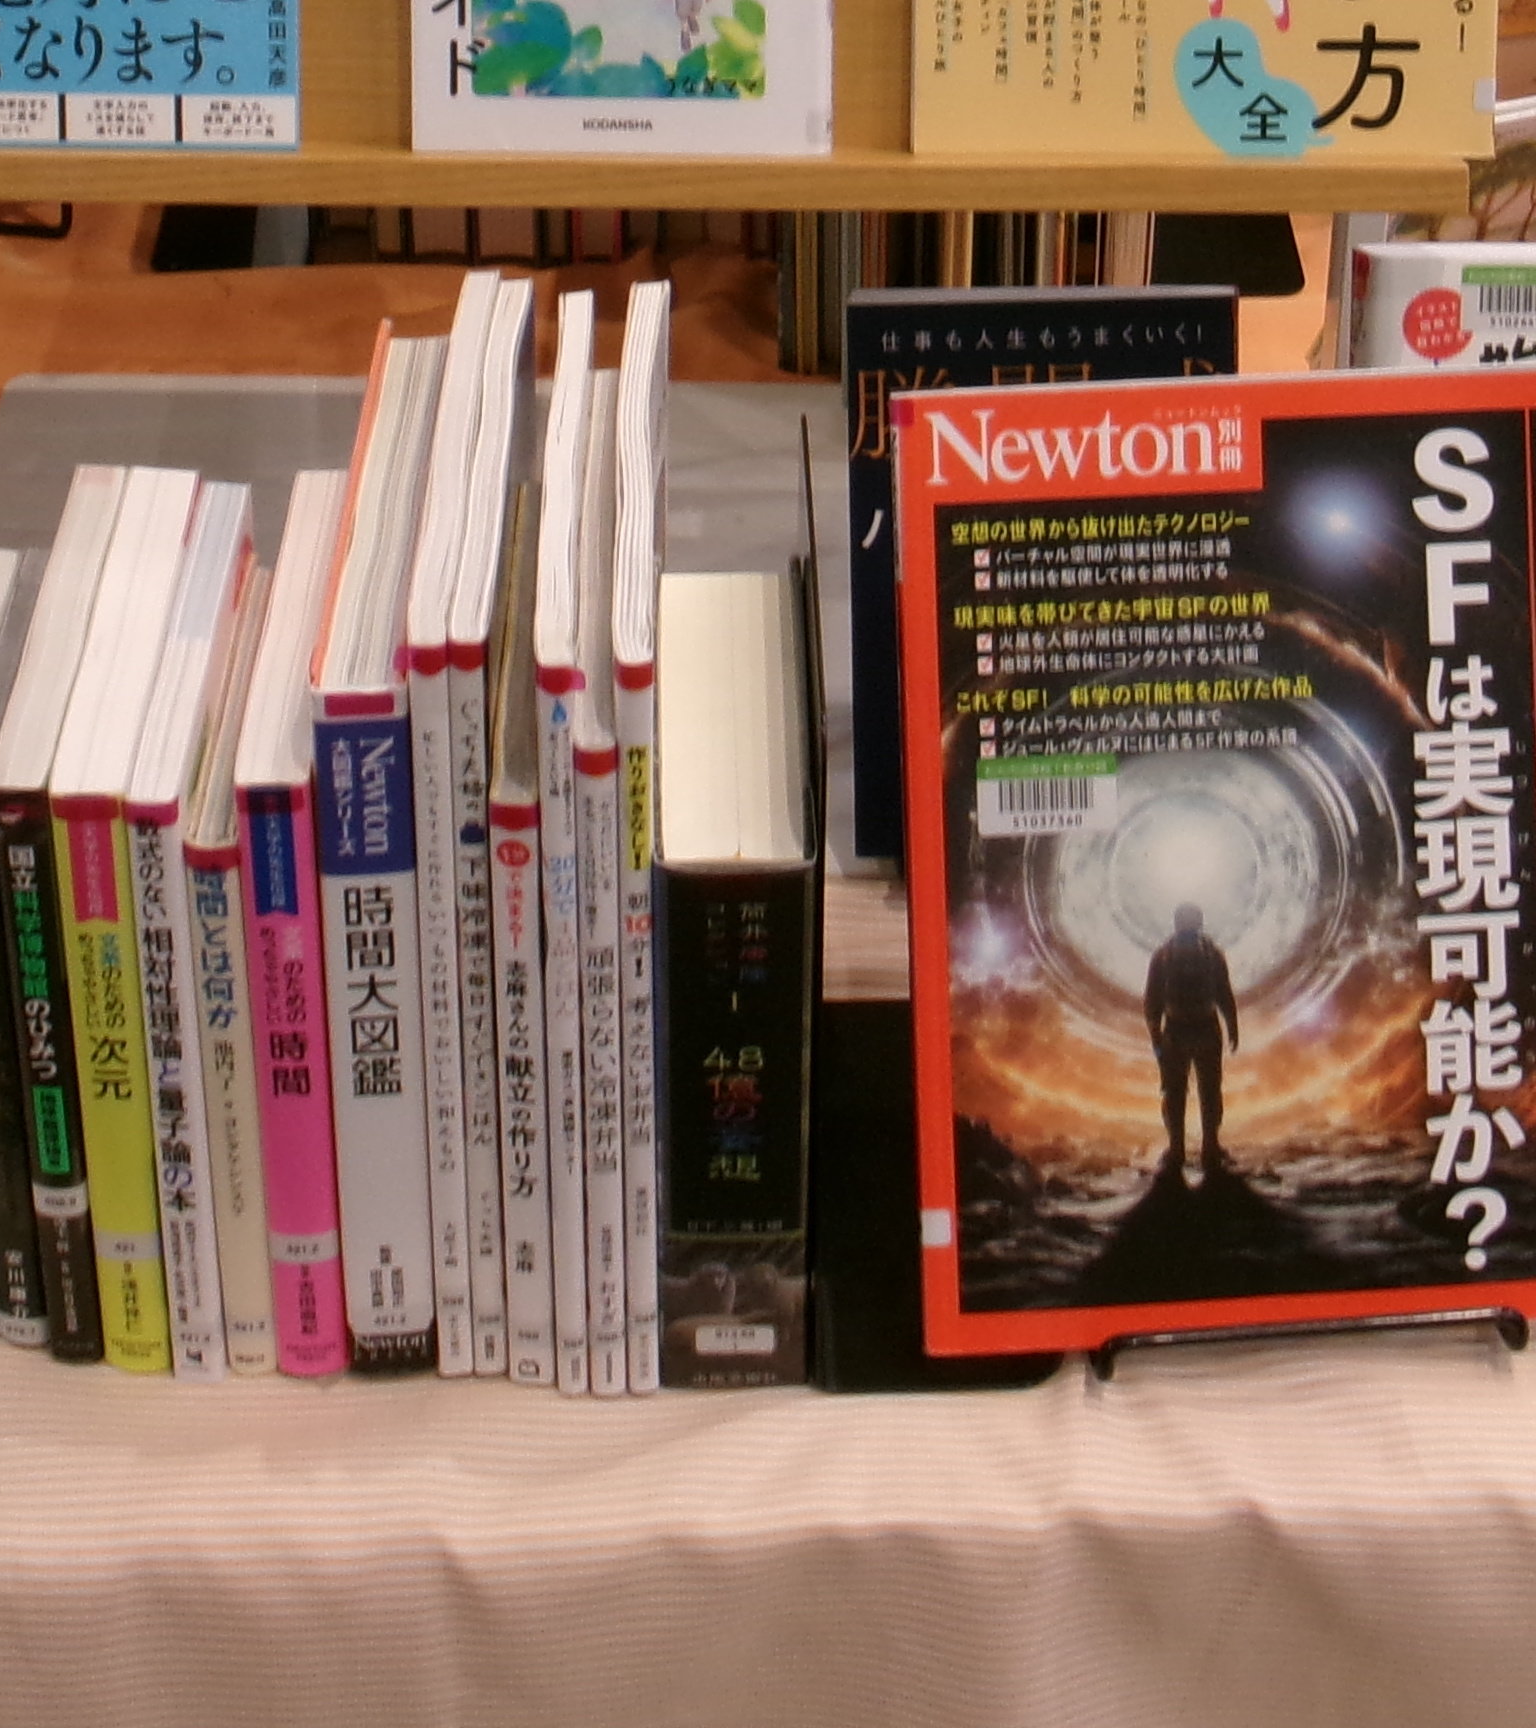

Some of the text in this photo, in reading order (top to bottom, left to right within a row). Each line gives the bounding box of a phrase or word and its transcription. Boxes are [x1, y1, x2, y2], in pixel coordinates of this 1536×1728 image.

[1192, 36, 1290, 142] 大全
[582, 117, 654, 132] KODANSHA
[880, 323, 1205, 353] 仕事も人生もうまくいく！
[925, 407, 1244, 486] Newton 別冊
[951, 510, 1250, 546] 空想の世界から抜け出たテクノロジー
[996, 562, 1229, 589] 新材料を駆使して体を透明化する
[953, 592, 1272, 630] 現実味を帯びてきた宇宙SFの世界
[999, 622, 1265, 651] 火星を人類が居住可能な惑星にかえる
[999, 645, 1260, 673] 地球外生命体にコンタクトする大計画
[1069, 675, 1314, 709] 科学の可能性を広げた作品
[1001, 707, 1223, 733] タイムトラベルから人造人間まで
[358, 735, 396, 856] Newton
[1412, 427, 1527, 1271] SFは実現可能か？
[343, 885, 403, 1097] 時間大図鑑
[88, 1035, 135, 1102] 次元
[268, 1031, 311, 1098] 時間
